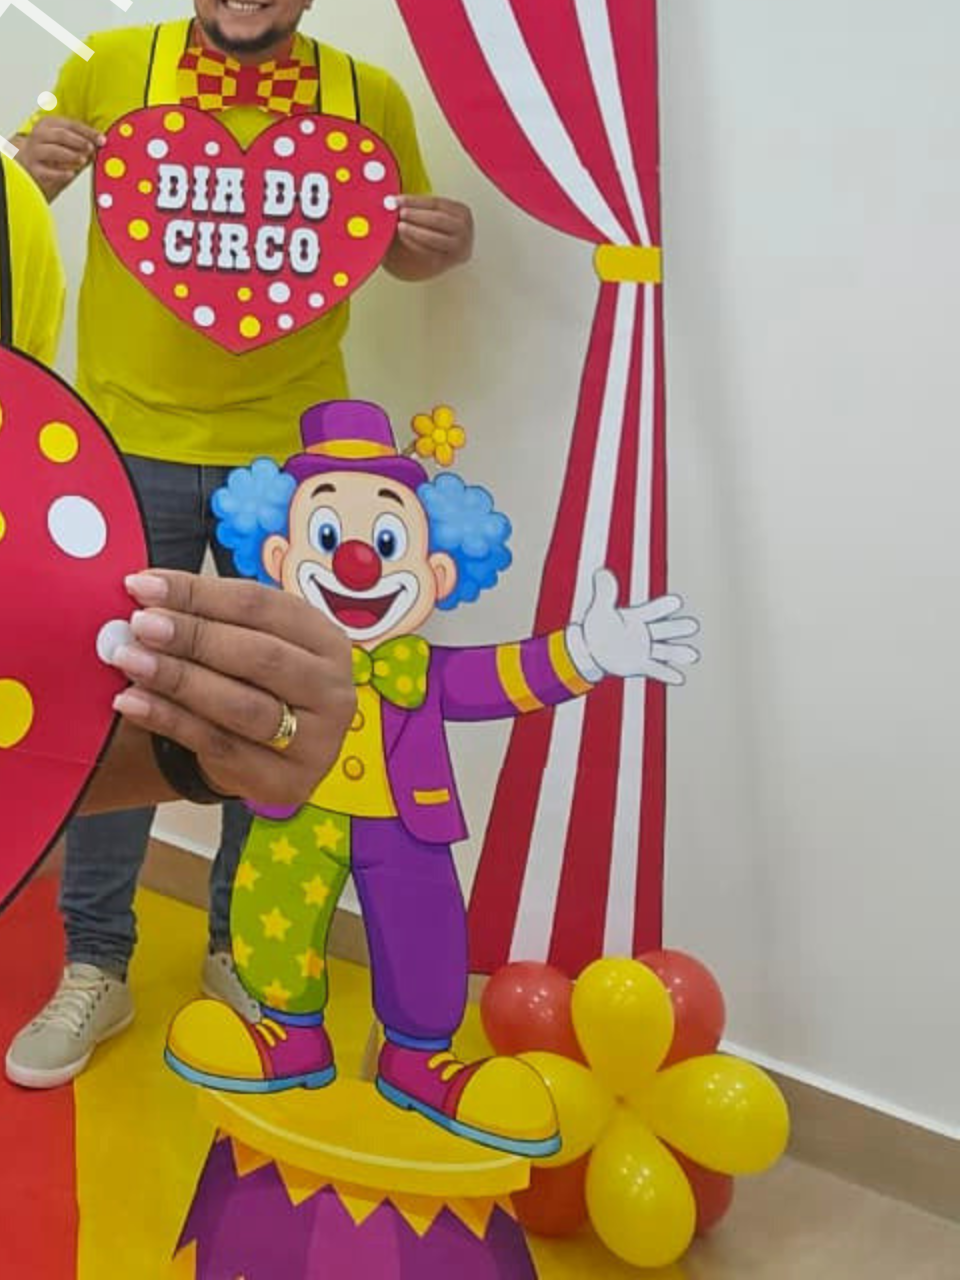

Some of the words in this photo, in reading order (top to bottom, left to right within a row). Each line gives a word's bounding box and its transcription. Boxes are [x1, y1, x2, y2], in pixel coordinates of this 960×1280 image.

[156, 163, 246, 215] DIA
[263, 169, 331, 220] DO
[163, 219, 321, 274] CIRCO
